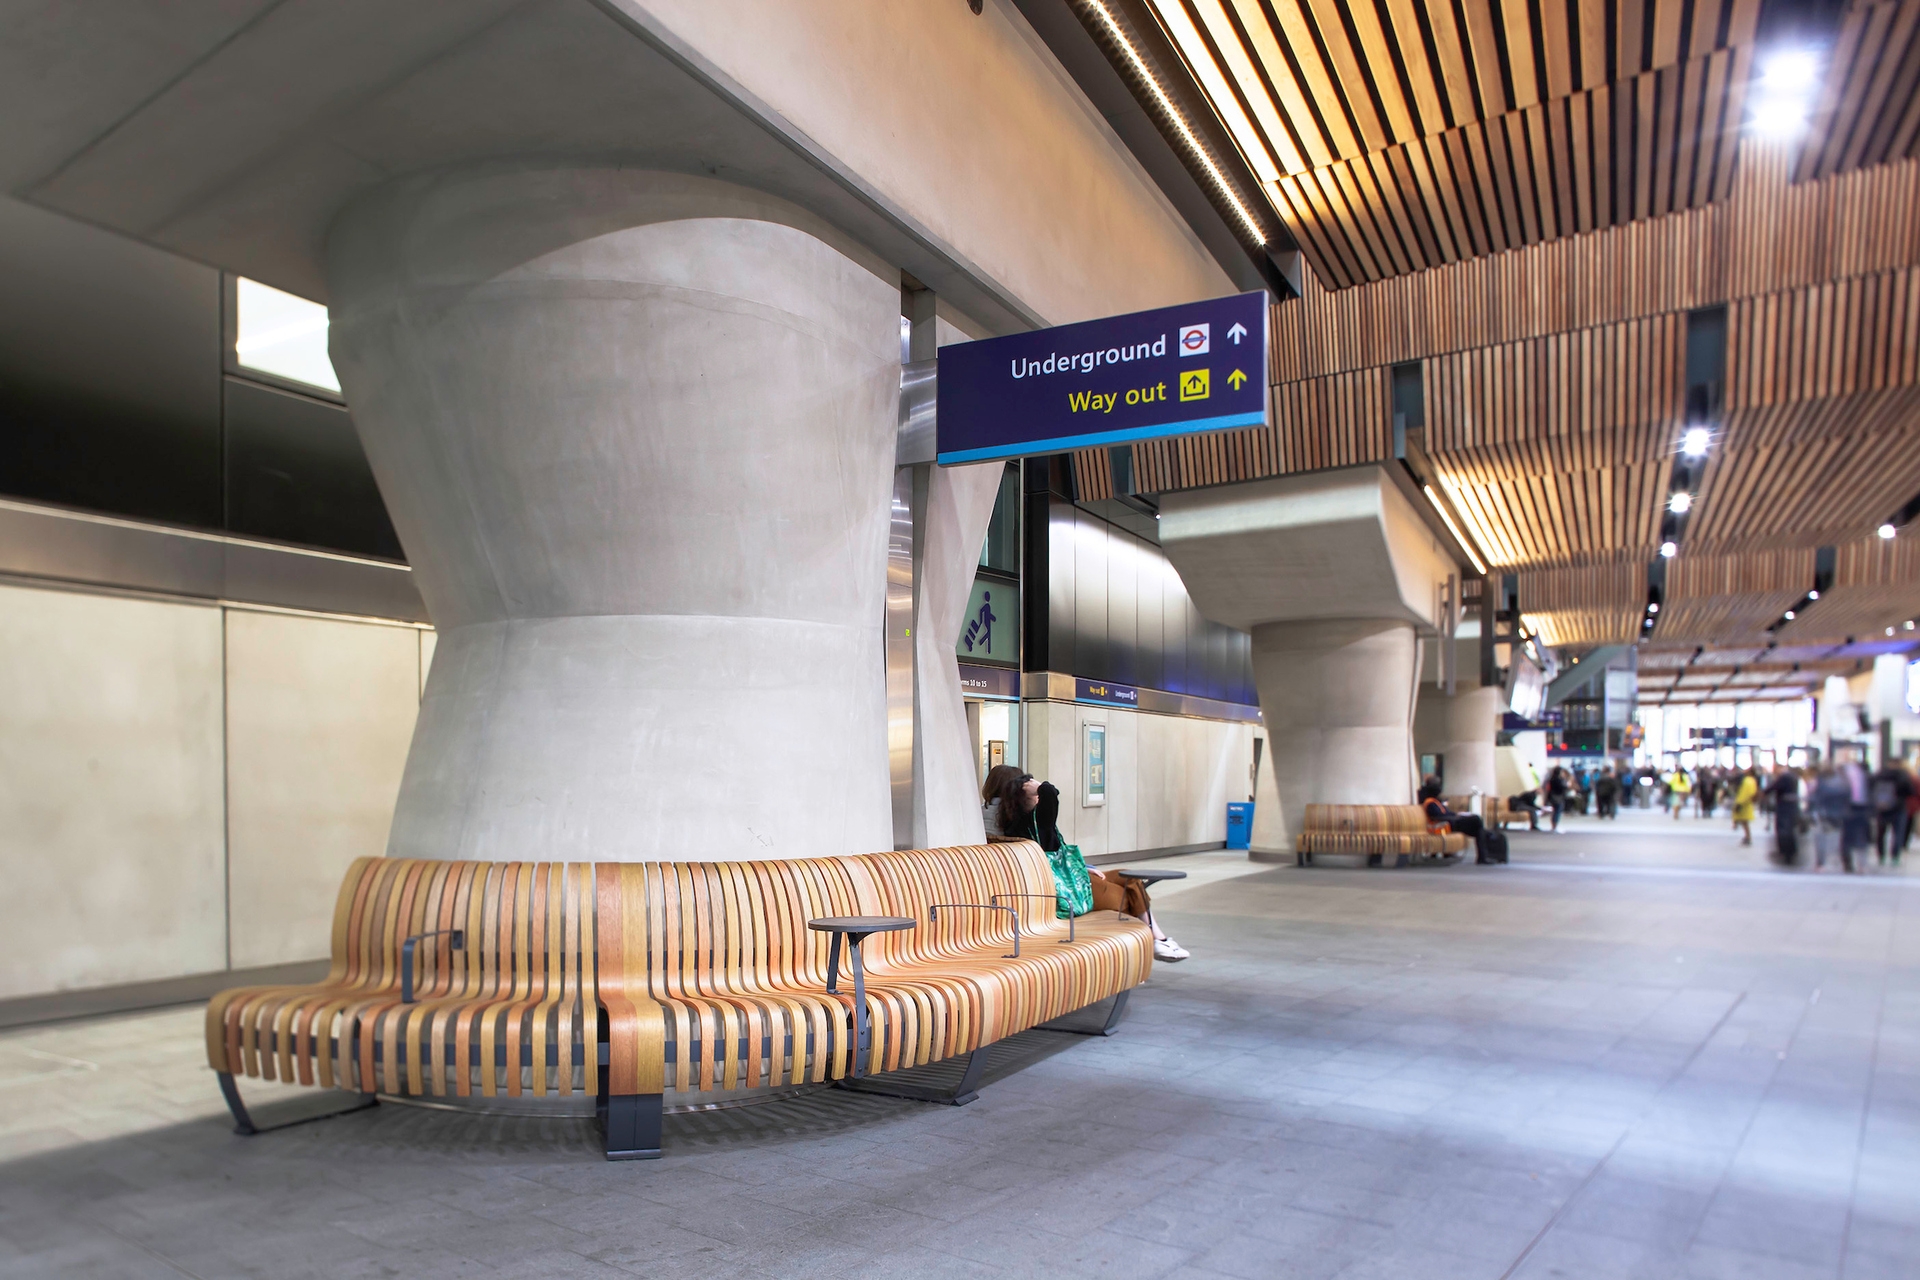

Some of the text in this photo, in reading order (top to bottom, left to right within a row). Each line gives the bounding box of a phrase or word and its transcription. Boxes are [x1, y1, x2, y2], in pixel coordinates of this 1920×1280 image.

[1010, 334, 1167, 380] Underground
[1067, 381, 1167, 415] Way out
[981, 680, 987, 688] 15
